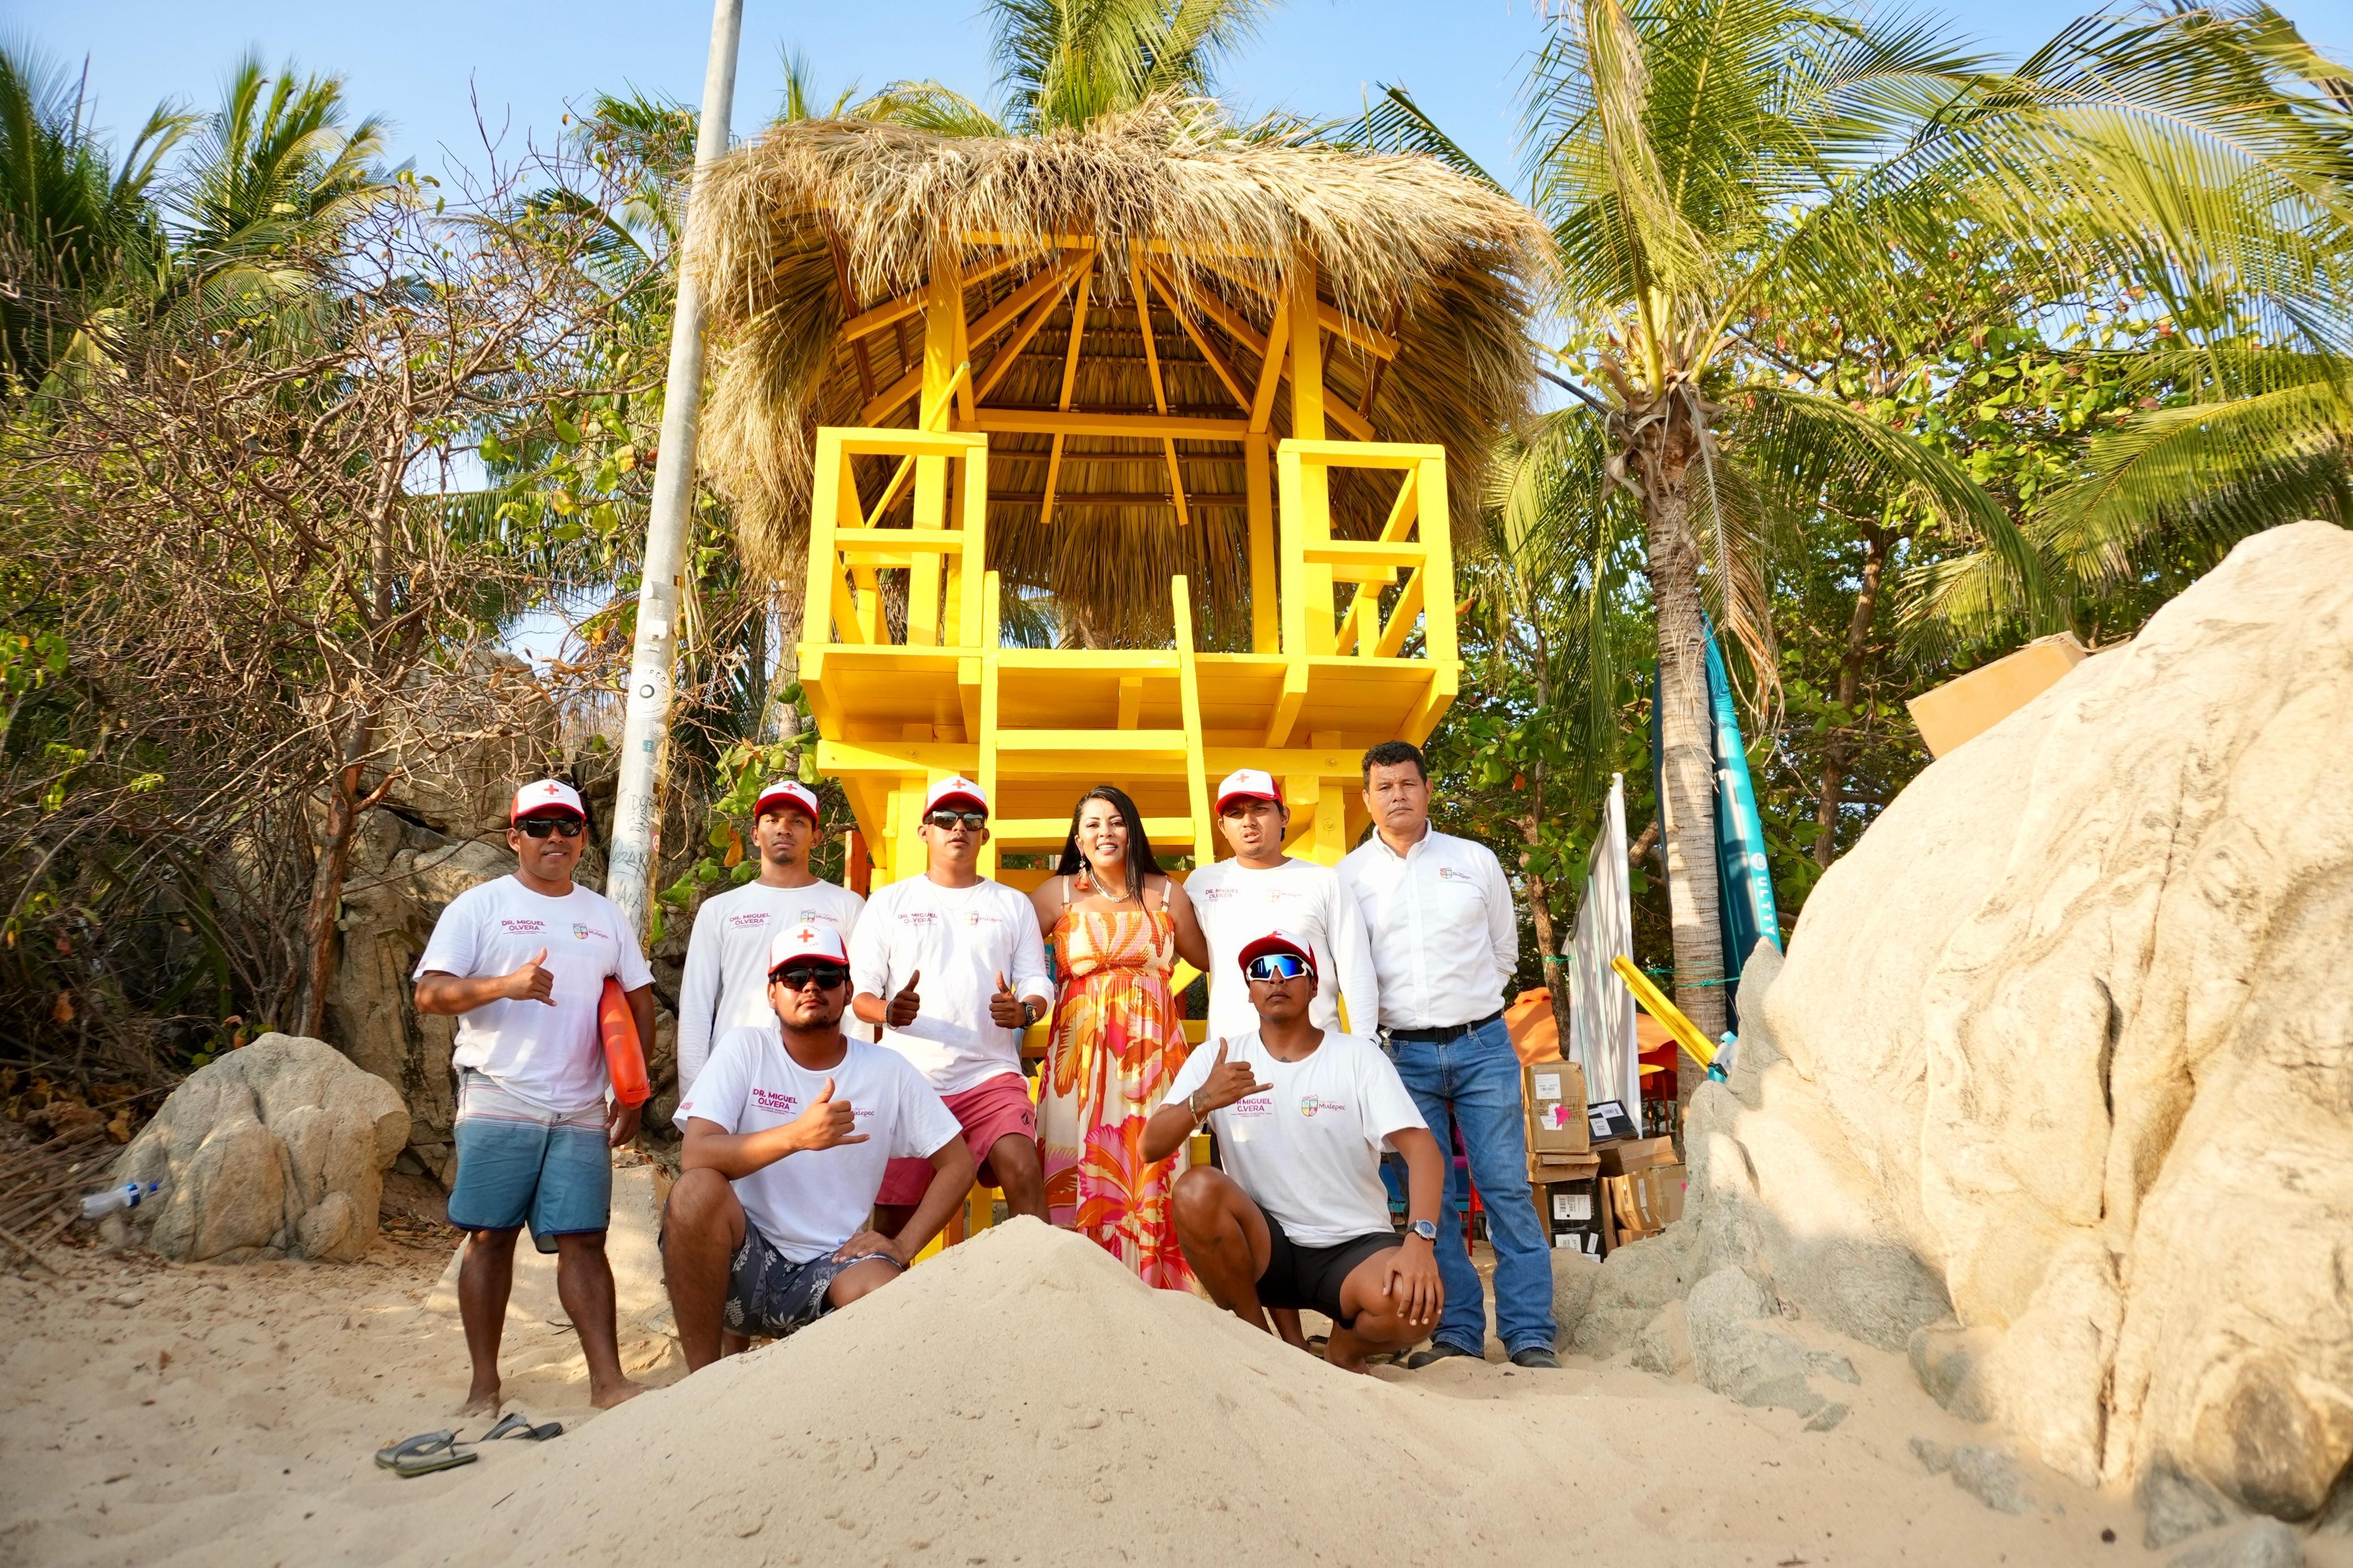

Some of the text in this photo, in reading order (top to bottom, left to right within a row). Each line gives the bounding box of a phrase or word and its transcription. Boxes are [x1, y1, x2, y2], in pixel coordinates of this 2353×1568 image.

[1757, 876, 1776, 936] ULTTY
[753, 1088, 798, 1104] DR. MIGUEL
[758, 1098, 790, 1110] OLVERA
